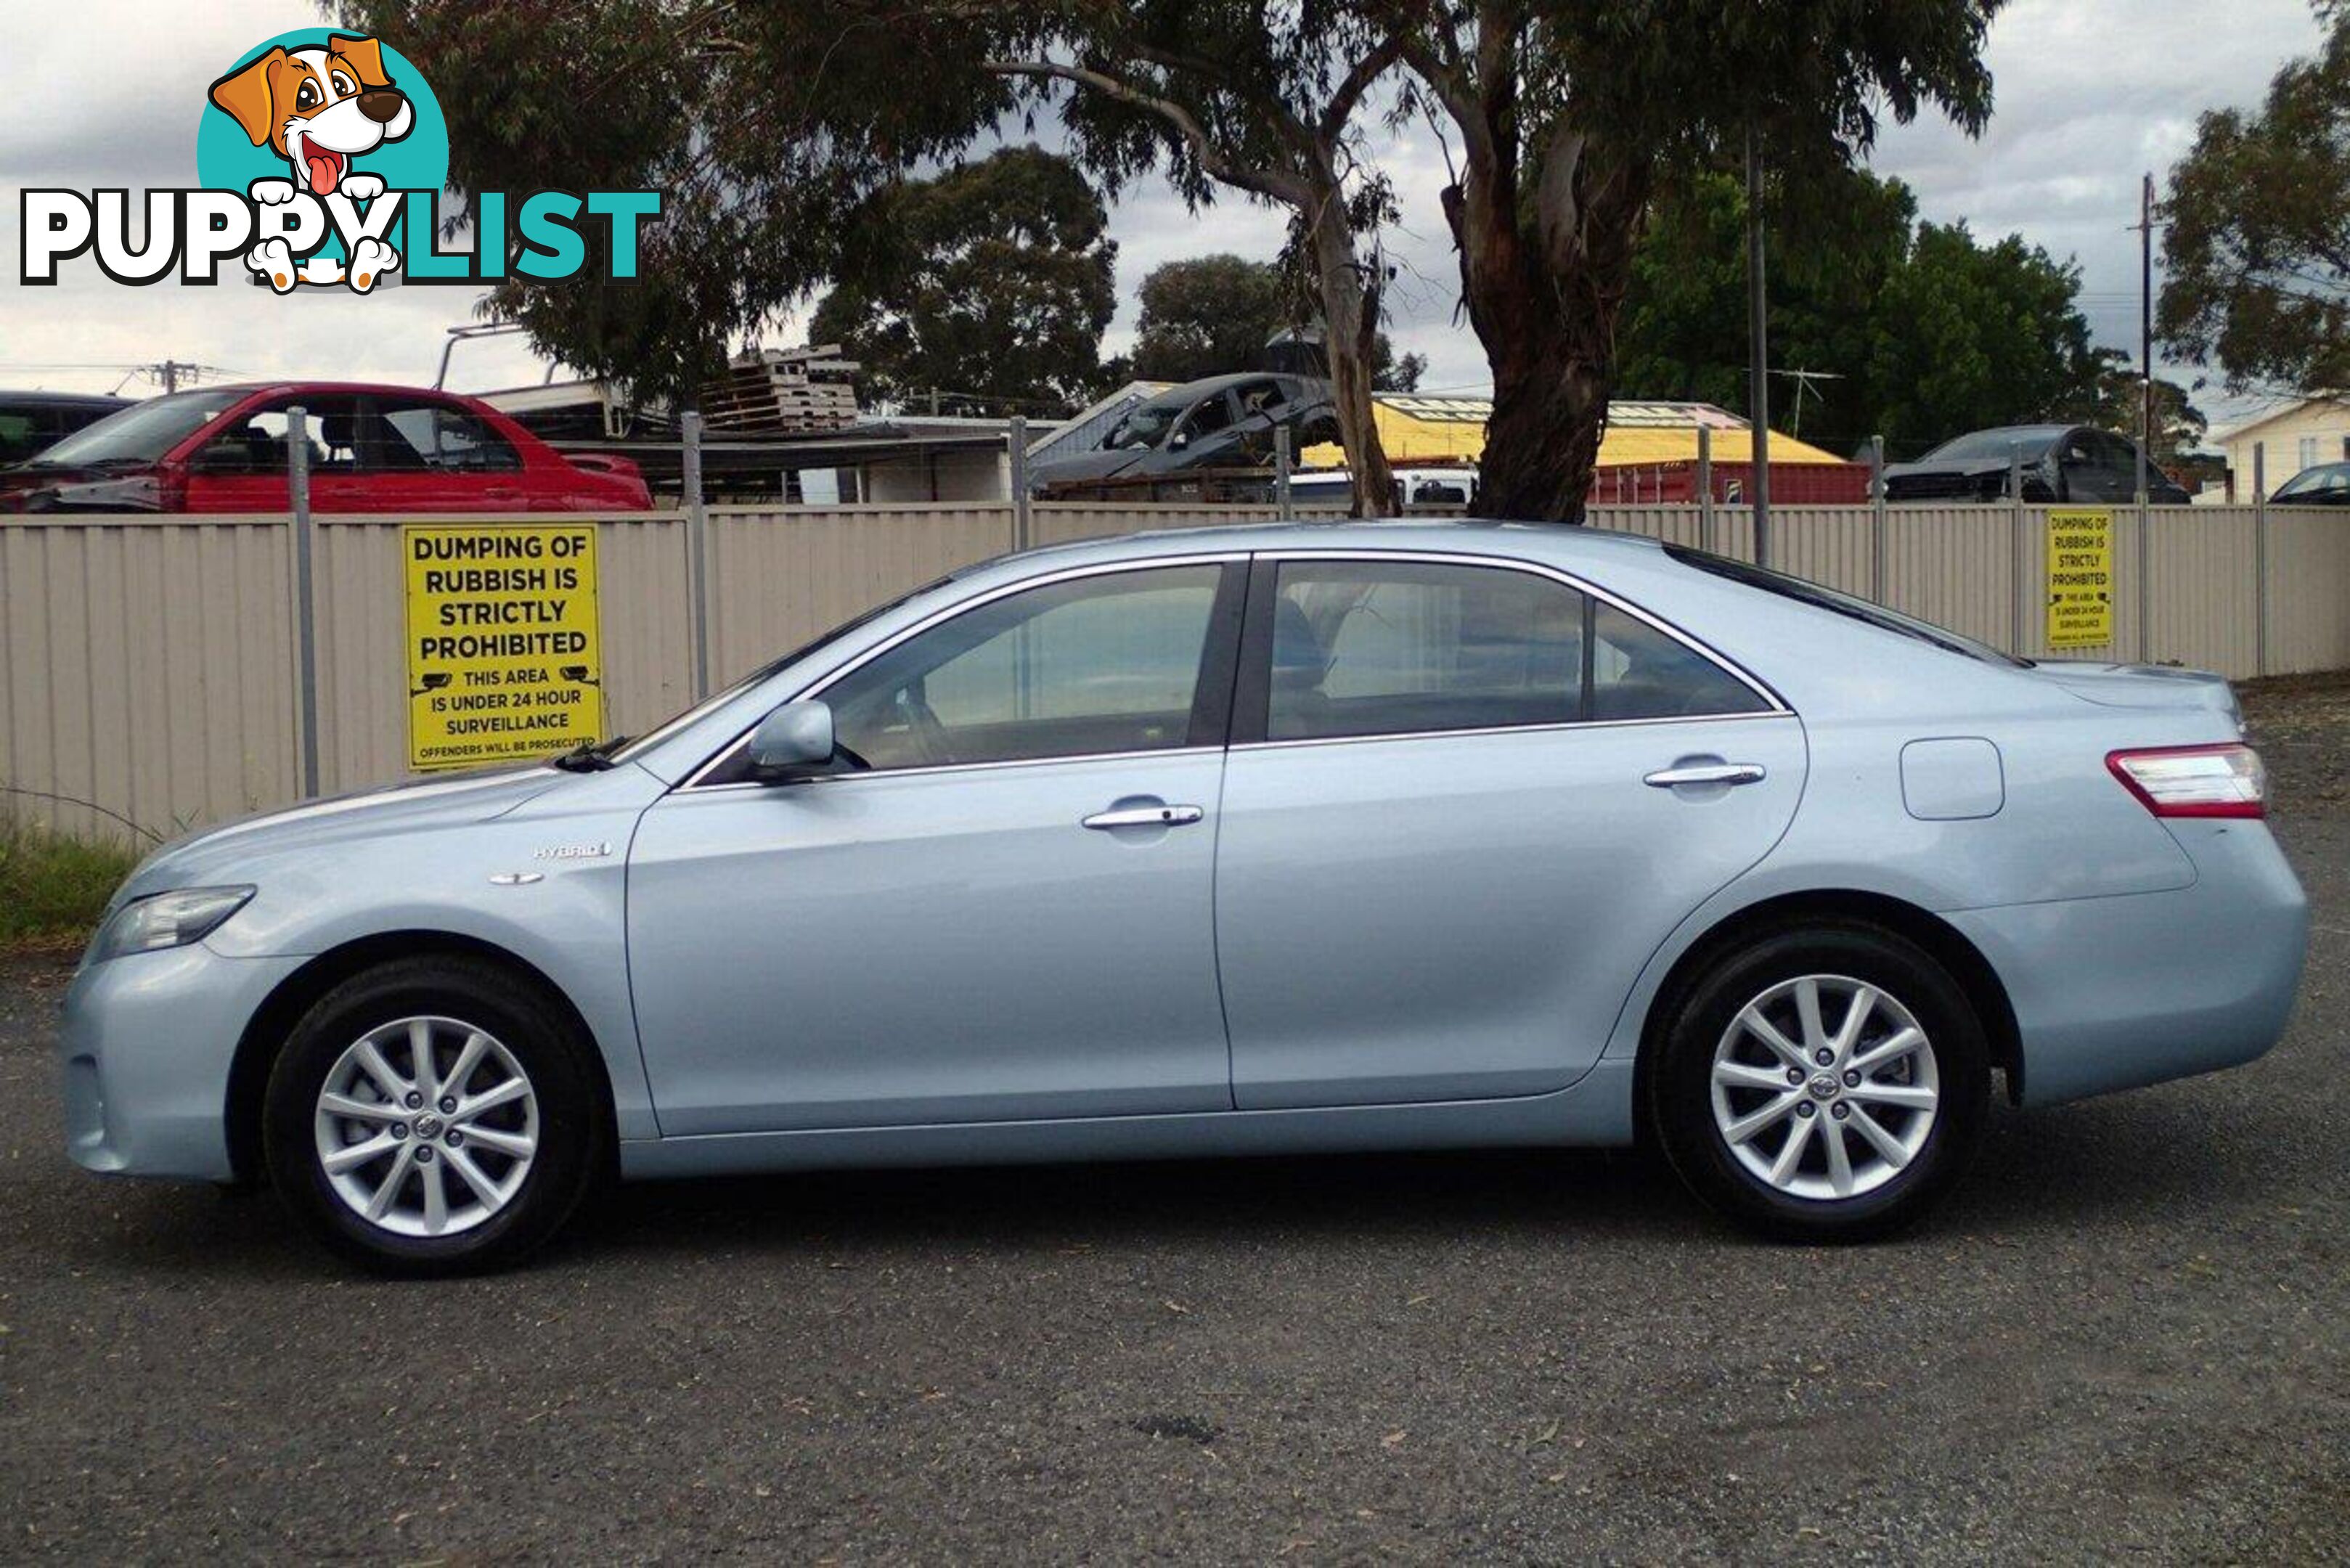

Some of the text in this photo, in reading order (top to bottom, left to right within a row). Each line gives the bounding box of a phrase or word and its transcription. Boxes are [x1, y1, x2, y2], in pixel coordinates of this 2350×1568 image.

[2052, 517, 2108, 530] DUMPING OF
[414, 536, 586, 560] DUMPING OF
[2059, 554, 2100, 568] STRICTLY
[425, 568, 578, 593] RUBBISH IS
[2052, 573, 2106, 587] PROHIBITED
[440, 600, 566, 626] STRICTLY
[421, 632, 587, 659] PROHIBITED
[464, 669, 550, 686] THIS AREA
[431, 690, 581, 712] IS UNDER 24 HOUR
[446, 714, 568, 735] SURVEILLANCE
[420, 737, 595, 758] OFFENDERS WILL BE PROSECUTED
[534, 845, 597, 858] HYBRID
